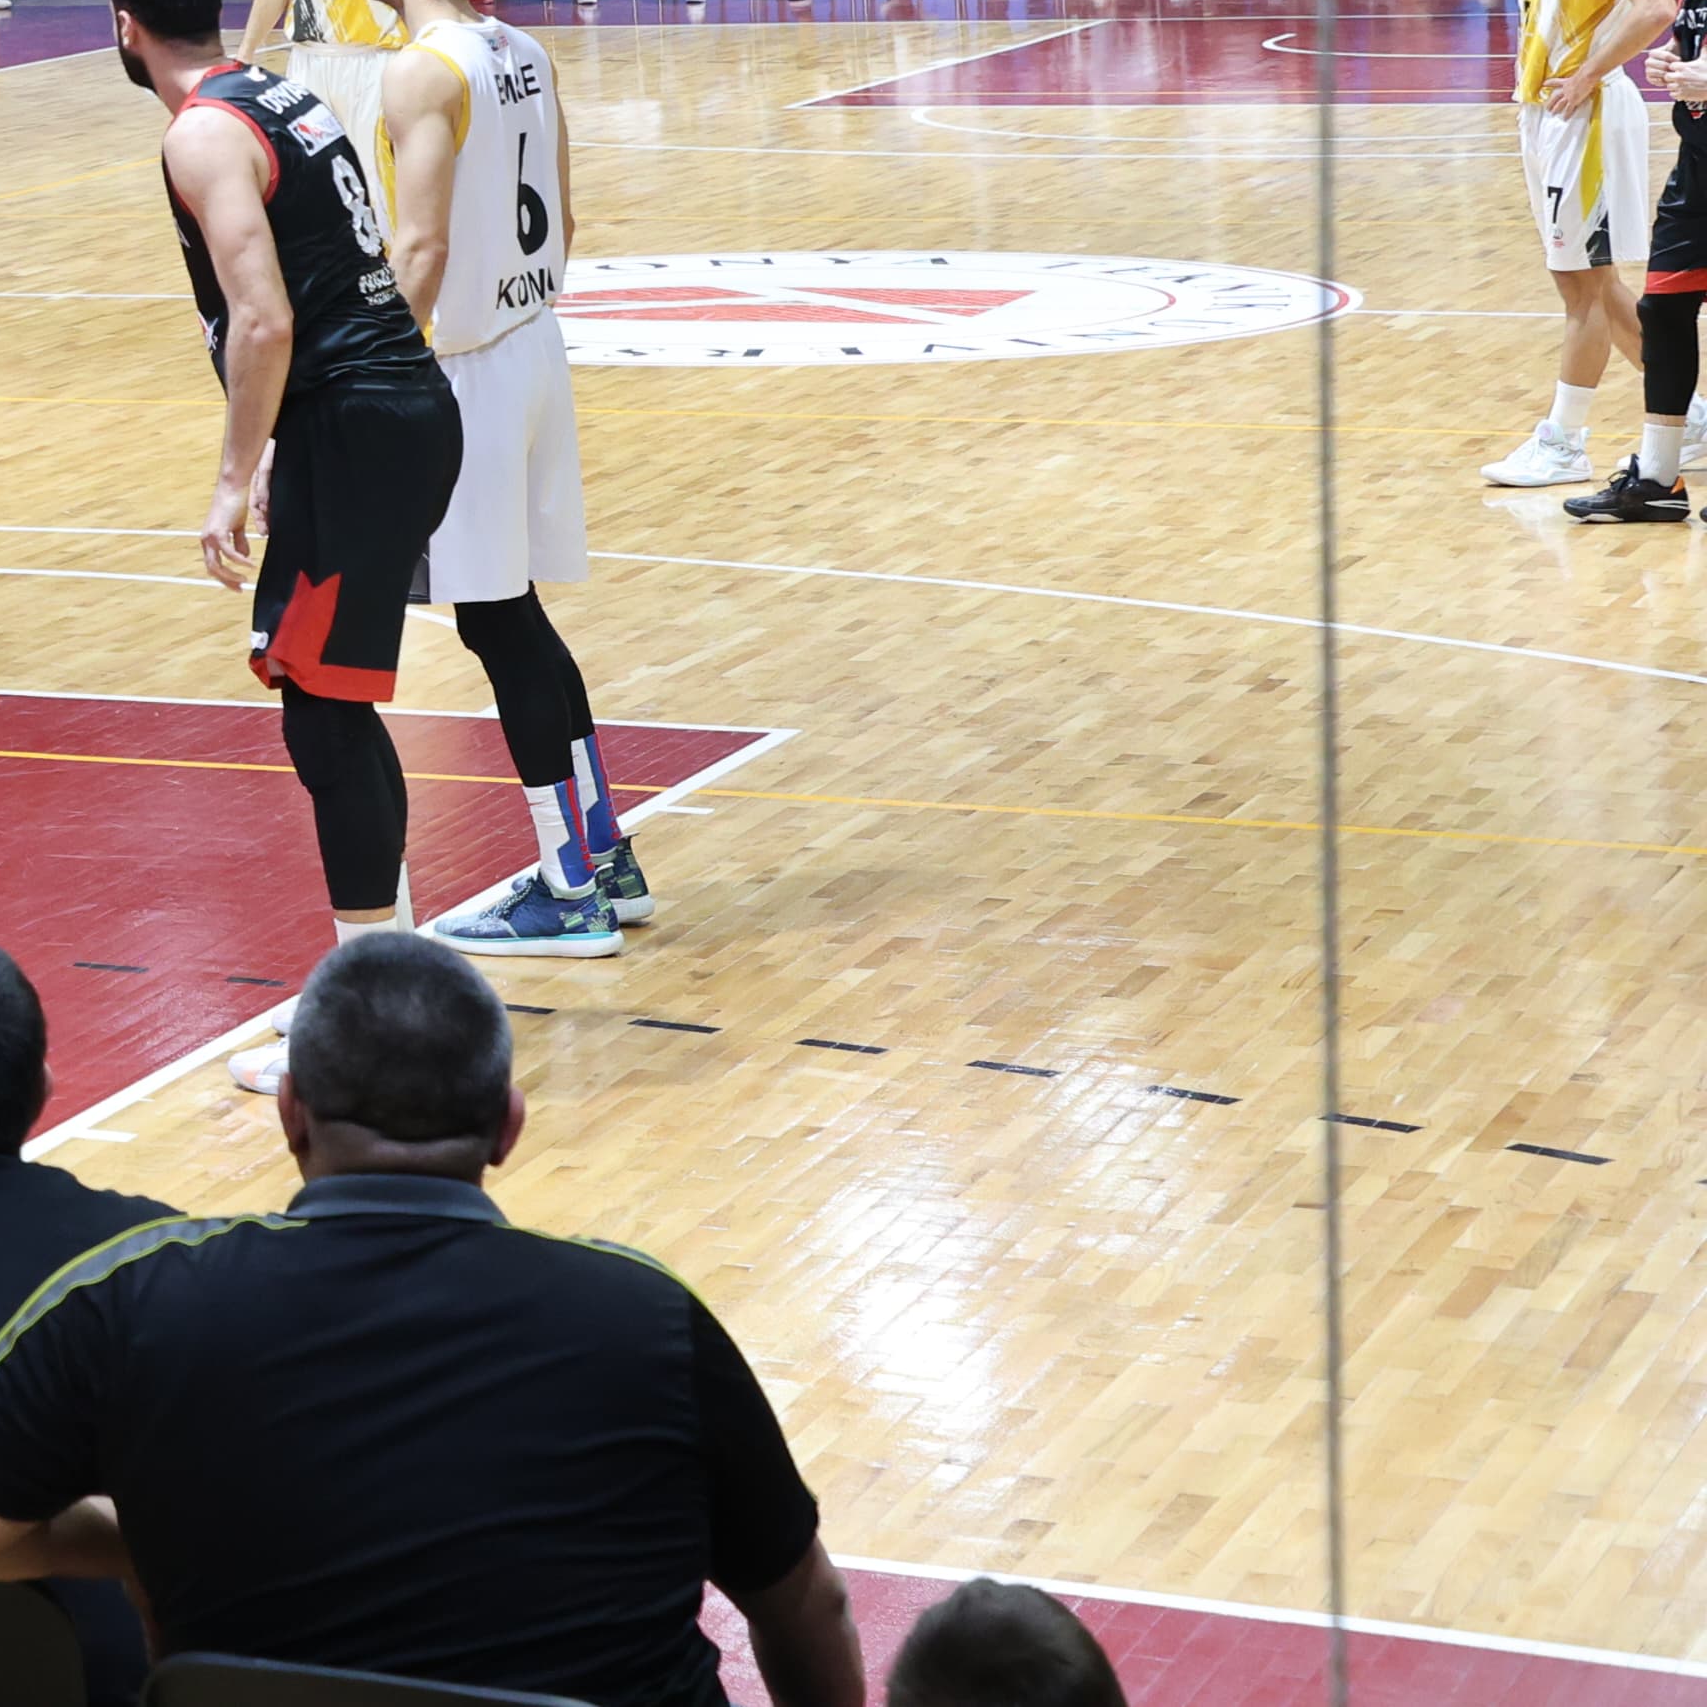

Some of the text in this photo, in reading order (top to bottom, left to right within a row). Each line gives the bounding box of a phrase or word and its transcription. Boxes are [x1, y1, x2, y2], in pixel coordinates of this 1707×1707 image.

[331, 154, 383, 258] 8
[516, 132, 549, 256] 6
[1547, 186, 1563, 224] 7
